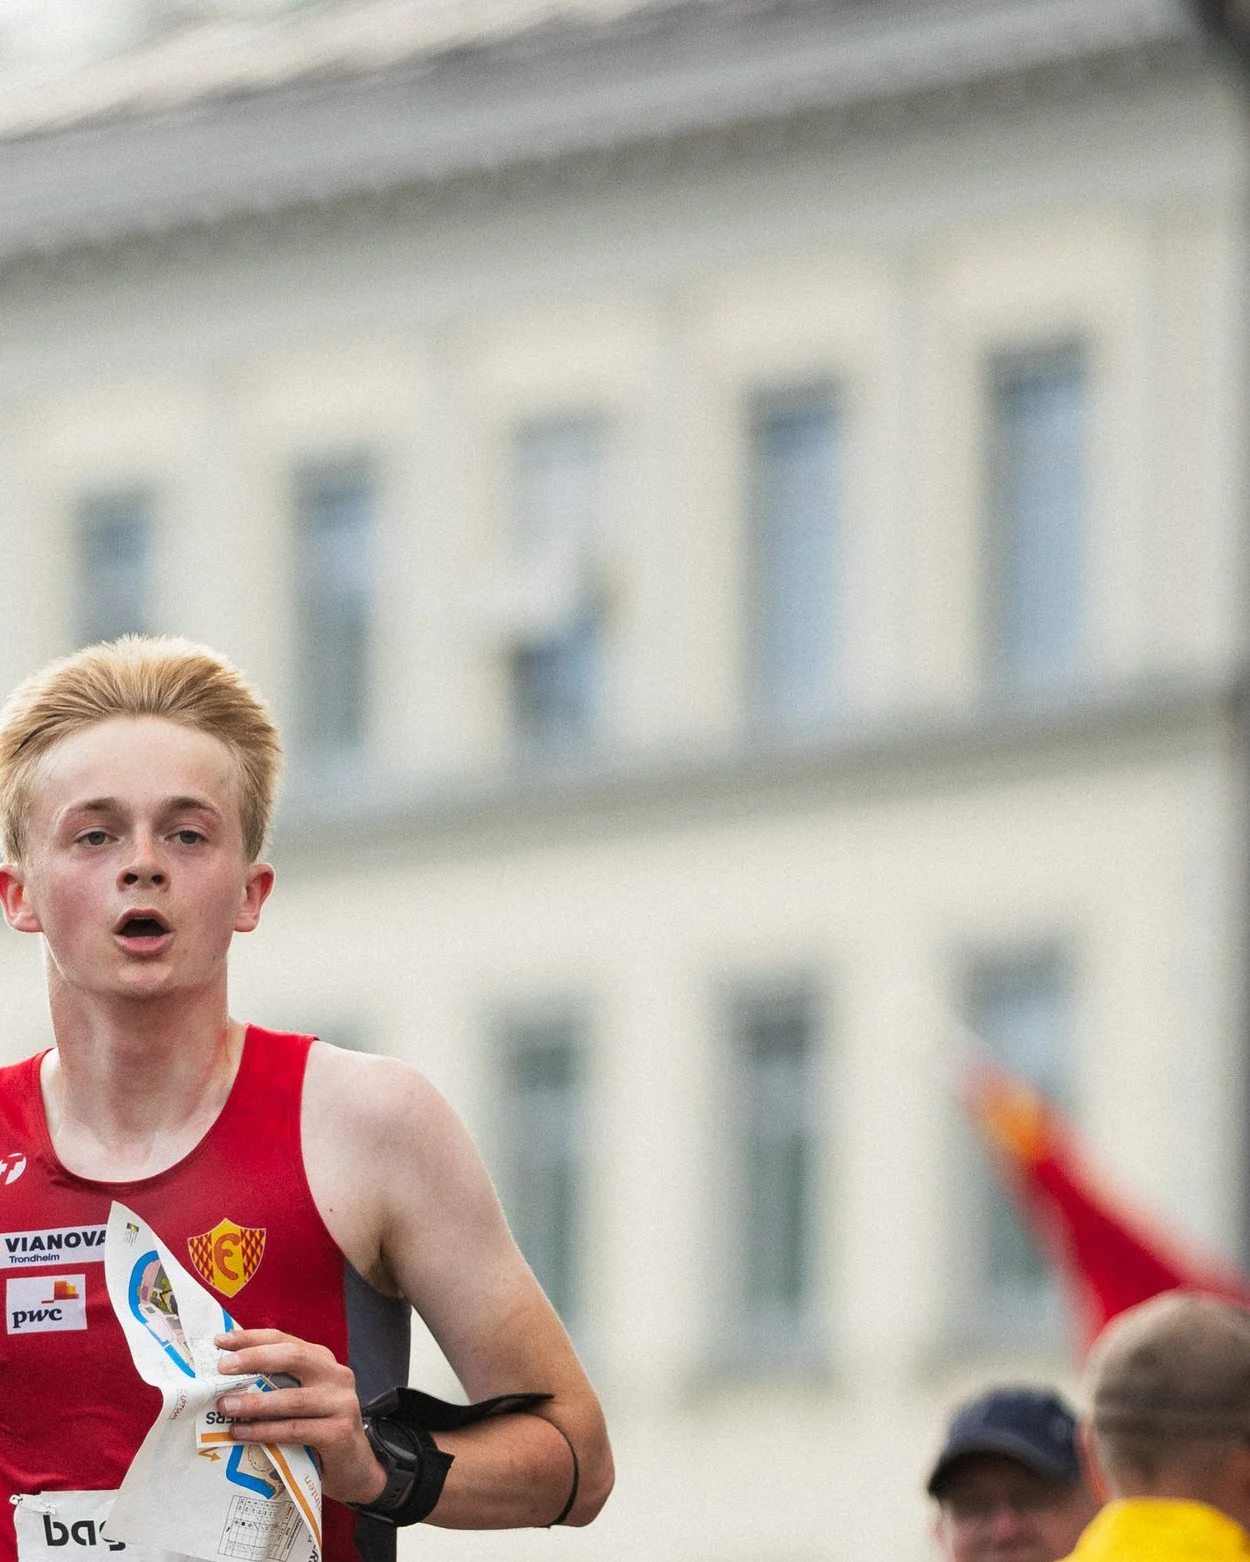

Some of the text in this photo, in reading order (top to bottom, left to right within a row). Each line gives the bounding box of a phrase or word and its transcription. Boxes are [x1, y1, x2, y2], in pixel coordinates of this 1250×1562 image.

[5, 1230, 107, 1253] VIANOVA
[9, 1254, 60, 1264] Trondheim
[12, 1308, 63, 1329] pwc
